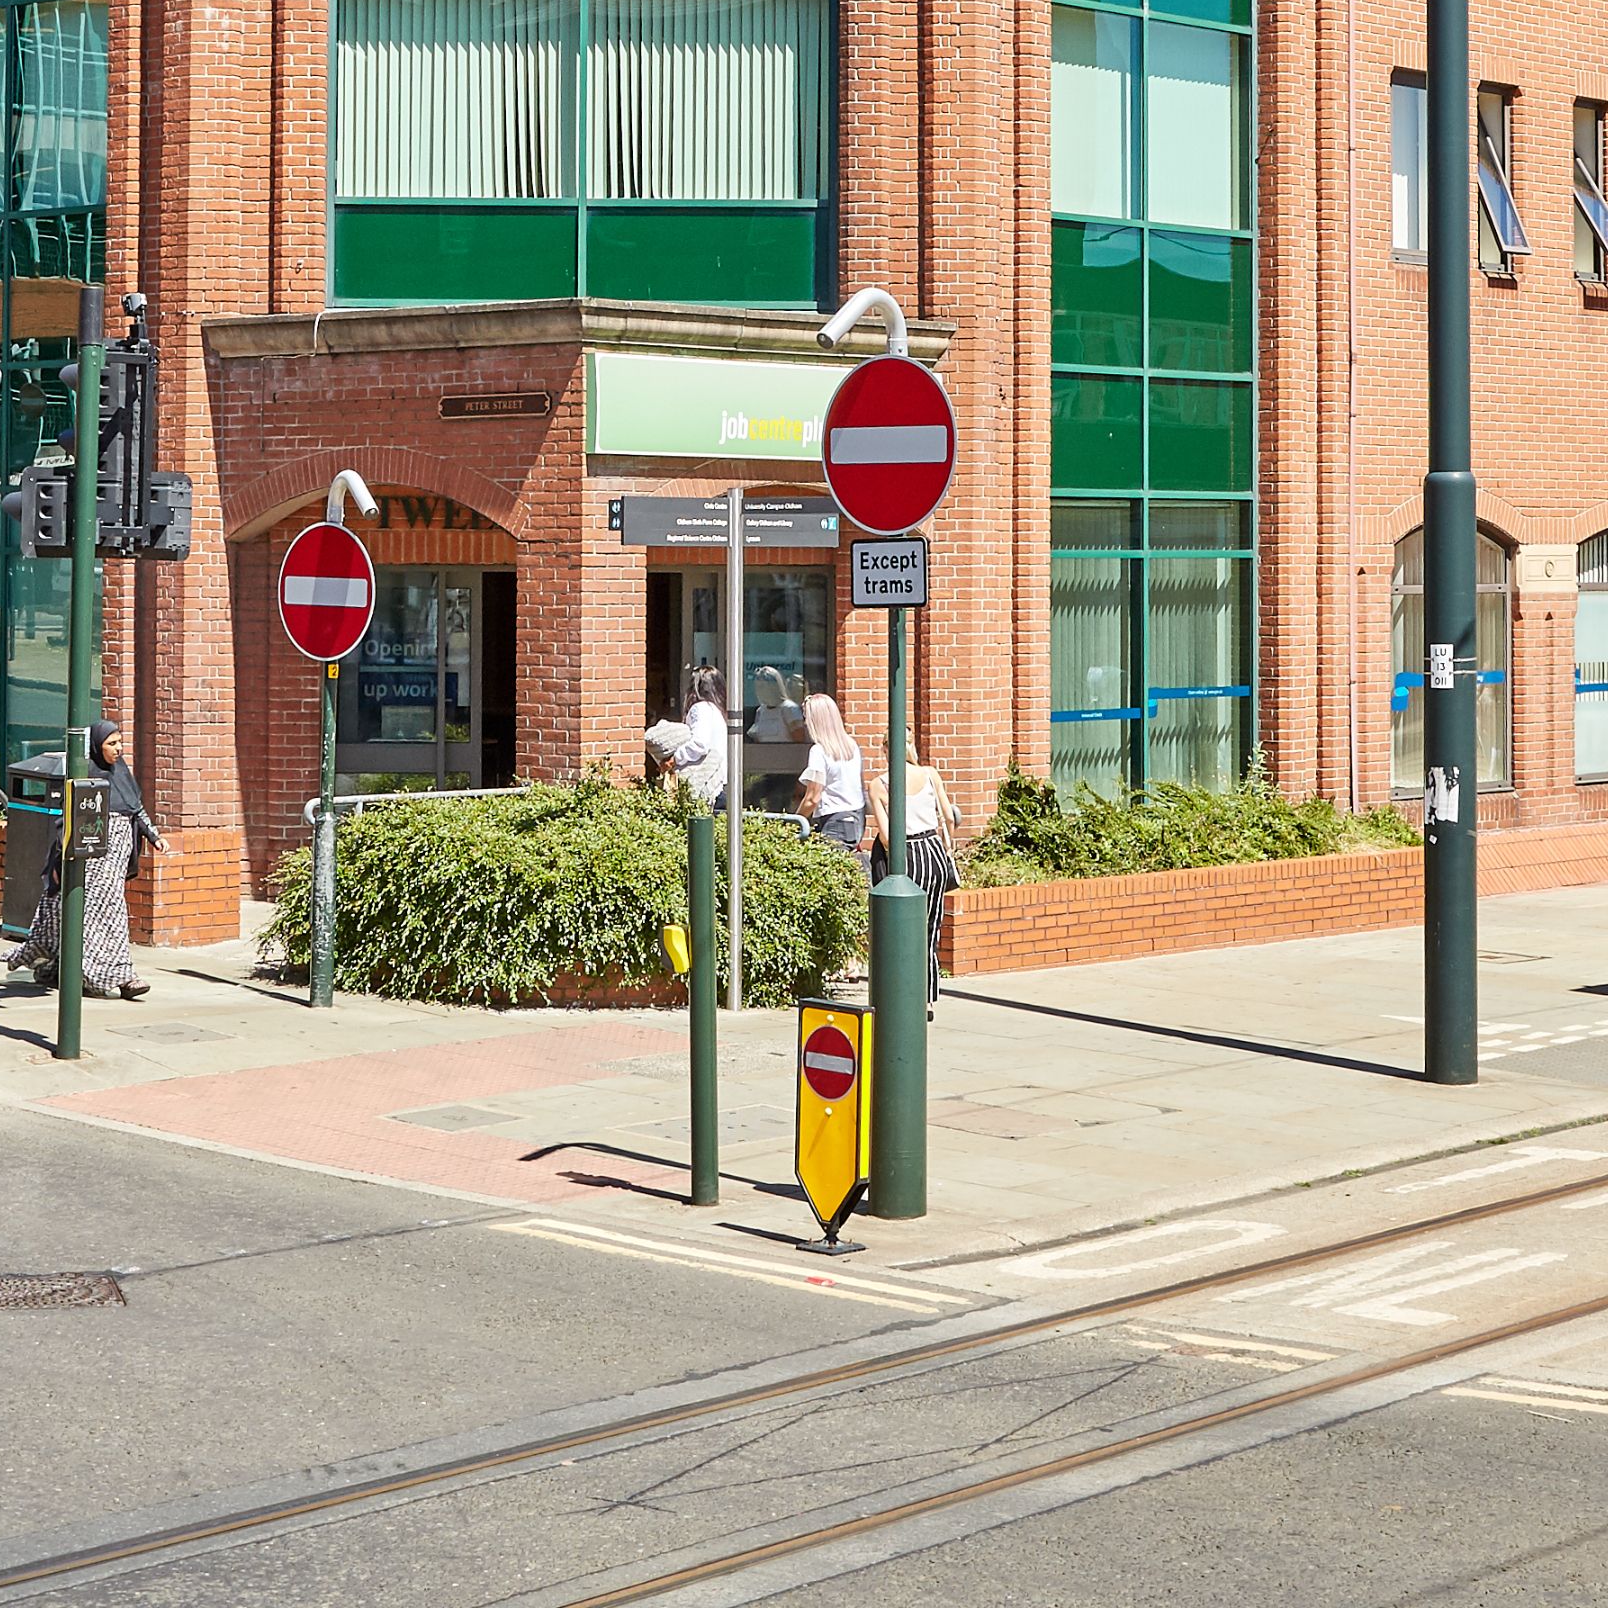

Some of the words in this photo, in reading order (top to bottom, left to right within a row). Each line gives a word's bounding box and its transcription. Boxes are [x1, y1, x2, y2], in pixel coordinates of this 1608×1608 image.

[465, 400, 490, 411] PETER
[493, 399, 523, 410] STREET
[719, 409, 822, 448] jobcentrepl
[859, 550, 918, 572] Except
[864, 576, 913, 594] trams
[364, 638, 438, 661] Openin
[1434, 648, 1447, 657] LU
[1436, 662, 1446, 671] 13
[363, 683, 388, 702] up
